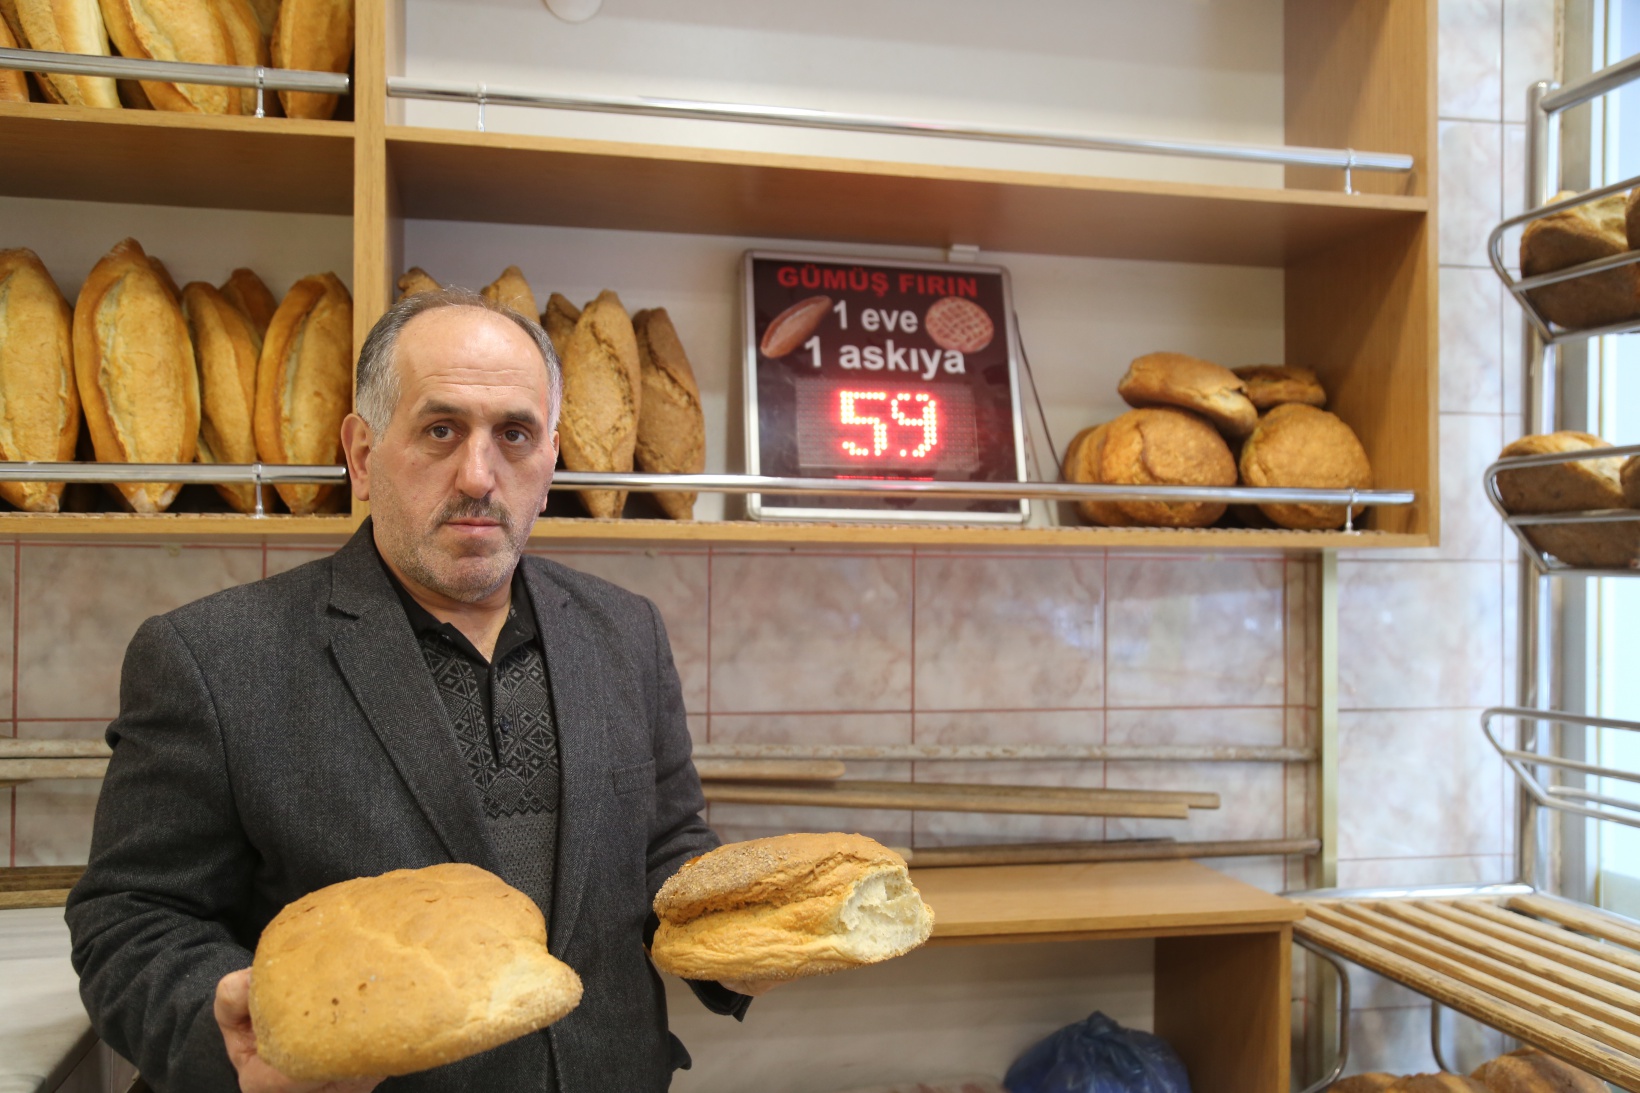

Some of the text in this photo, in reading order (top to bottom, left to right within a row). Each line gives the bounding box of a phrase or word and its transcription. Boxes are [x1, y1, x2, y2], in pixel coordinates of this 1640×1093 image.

[777, 264, 978, 297] GÜMÜŞ FIRIN
[833, 300, 918, 333] 1 eve
[805, 336, 965, 380] 1 askıya
[840, 390, 937, 458] 59
